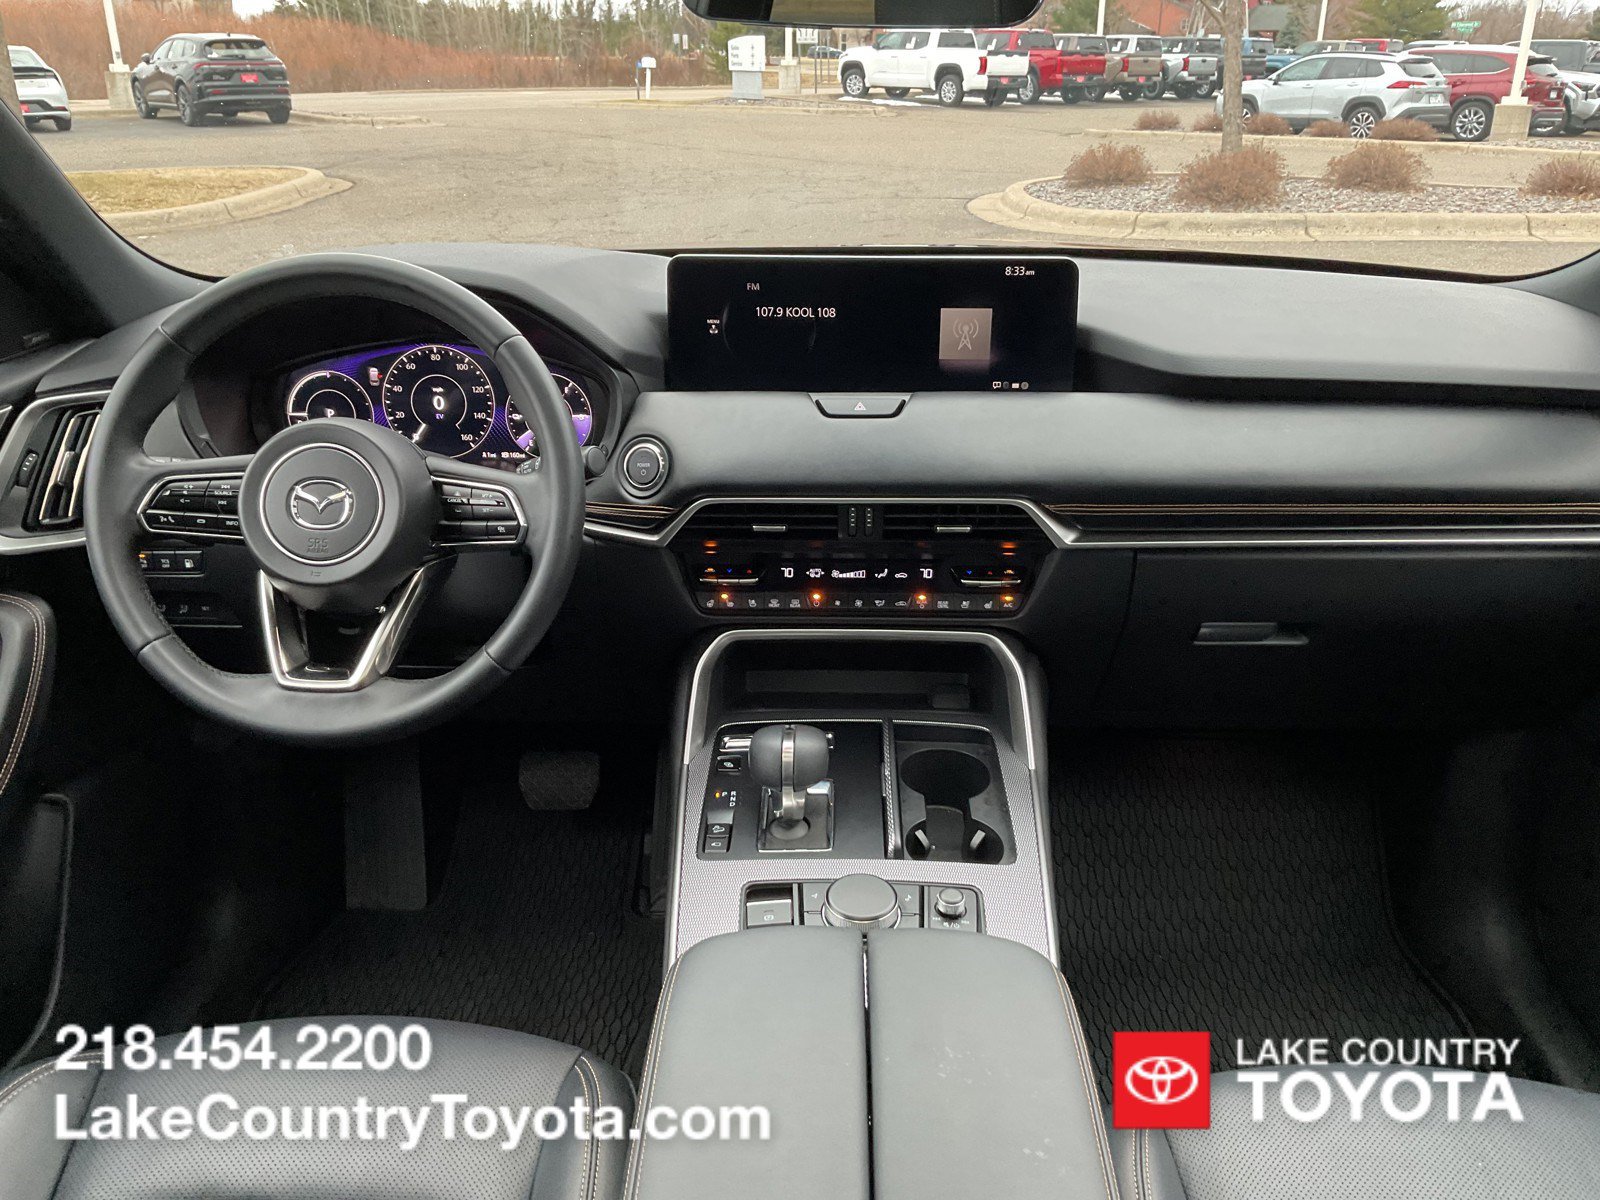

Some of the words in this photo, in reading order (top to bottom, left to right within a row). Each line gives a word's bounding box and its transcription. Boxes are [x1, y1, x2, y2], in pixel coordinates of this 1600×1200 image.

[746, 282, 760, 291] FM
[755, 306, 784, 318] 107.9
[785, 306, 815, 318] KOOL
[817, 307, 837, 318] 108
[455, 363, 469, 371] 100
[432, 395, 446, 411] 0
[307, 537, 328, 548] SRS
[780, 567, 794, 578] 70
[919, 568, 934, 579] 70
